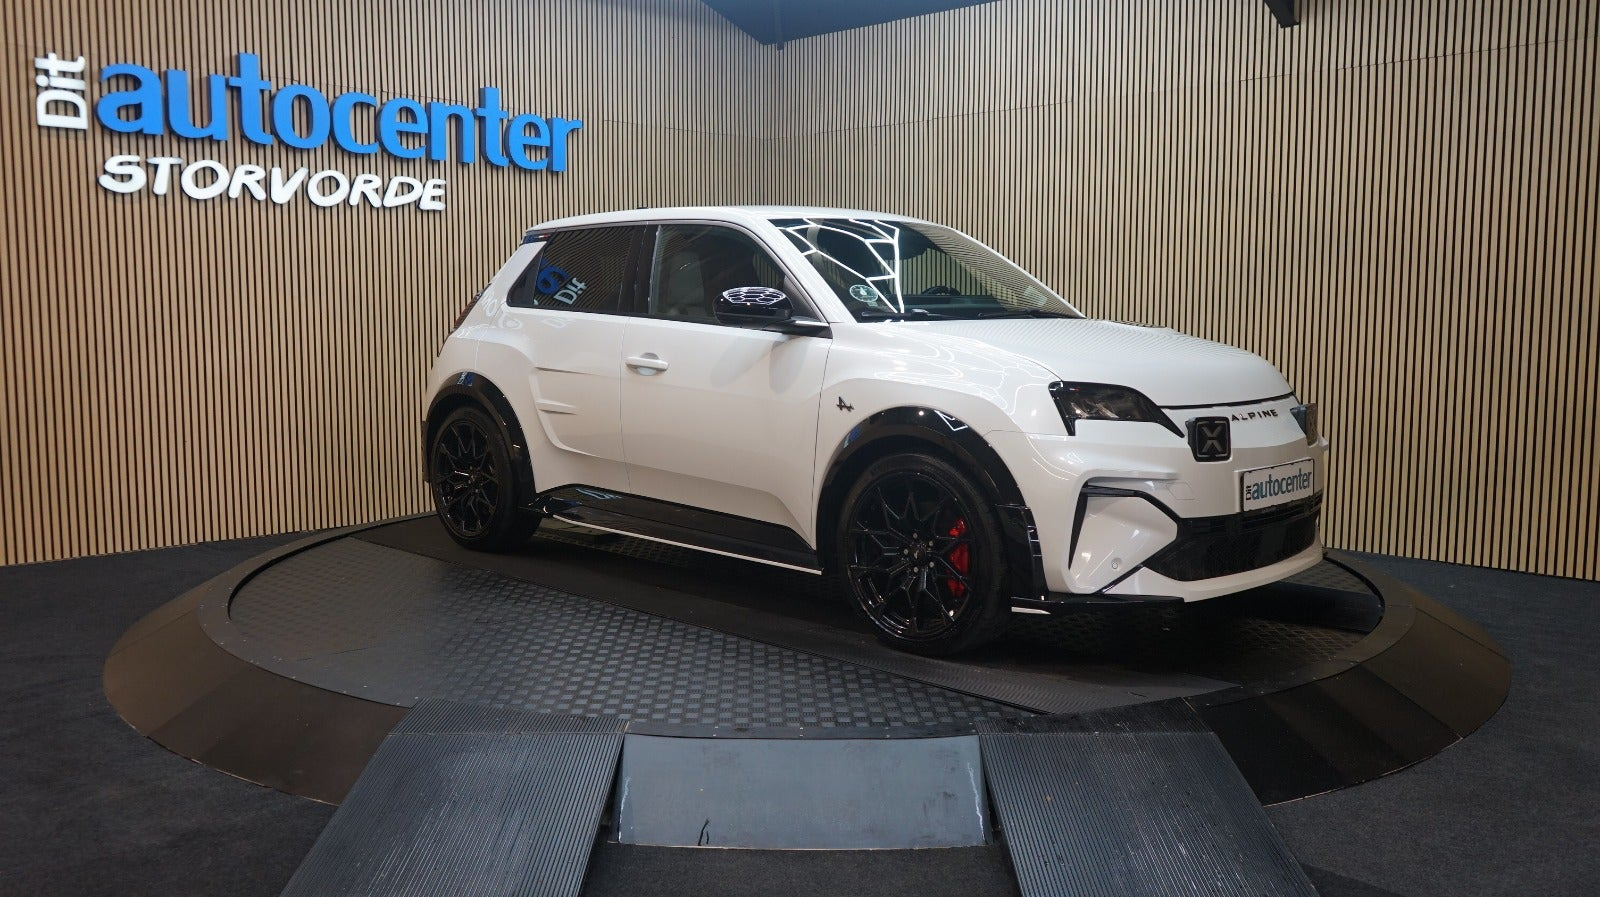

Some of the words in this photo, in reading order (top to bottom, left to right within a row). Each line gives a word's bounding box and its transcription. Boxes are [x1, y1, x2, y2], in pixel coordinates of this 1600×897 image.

[35, 52, 88, 130] Dit
[98, 52, 582, 172] autocenter
[99, 154, 446, 211] STORVORDE
[1231, 409, 1278, 421] ALPINE
[1252, 468, 1312, 500] autocenter
